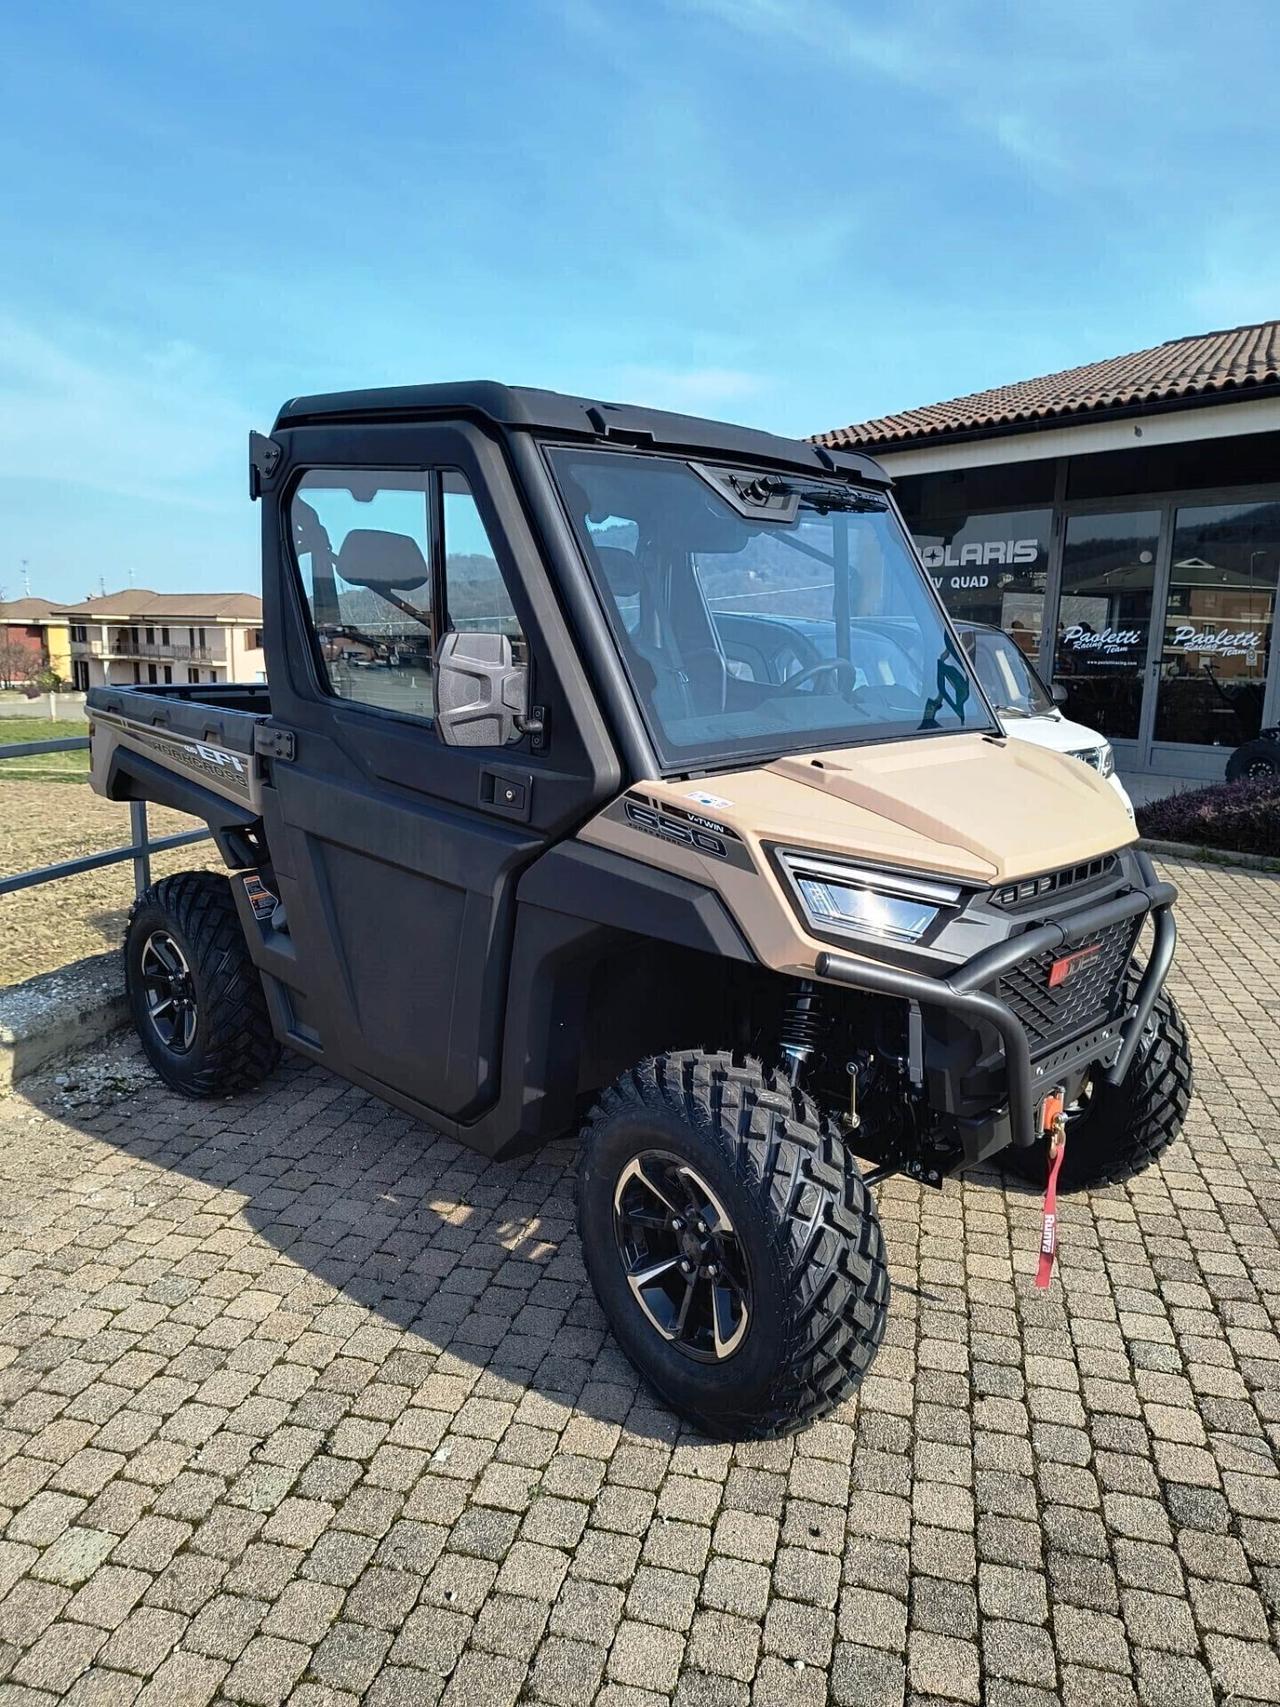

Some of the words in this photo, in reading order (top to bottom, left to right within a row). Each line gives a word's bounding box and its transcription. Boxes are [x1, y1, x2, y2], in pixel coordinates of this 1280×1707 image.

[950, 575, 989, 588] QUAD
[1064, 626, 1141, 644] Paoletti
[1173, 626, 1262, 646] Paoletti
[1073, 641, 1103, 650] Racing
[1104, 644, 1128, 654] Team
[196, 744, 244, 772] EFI
[624, 801, 728, 857] 650
[687, 813, 724, 833] V-TWIN
[1042, 1214, 1055, 1253] Runva
